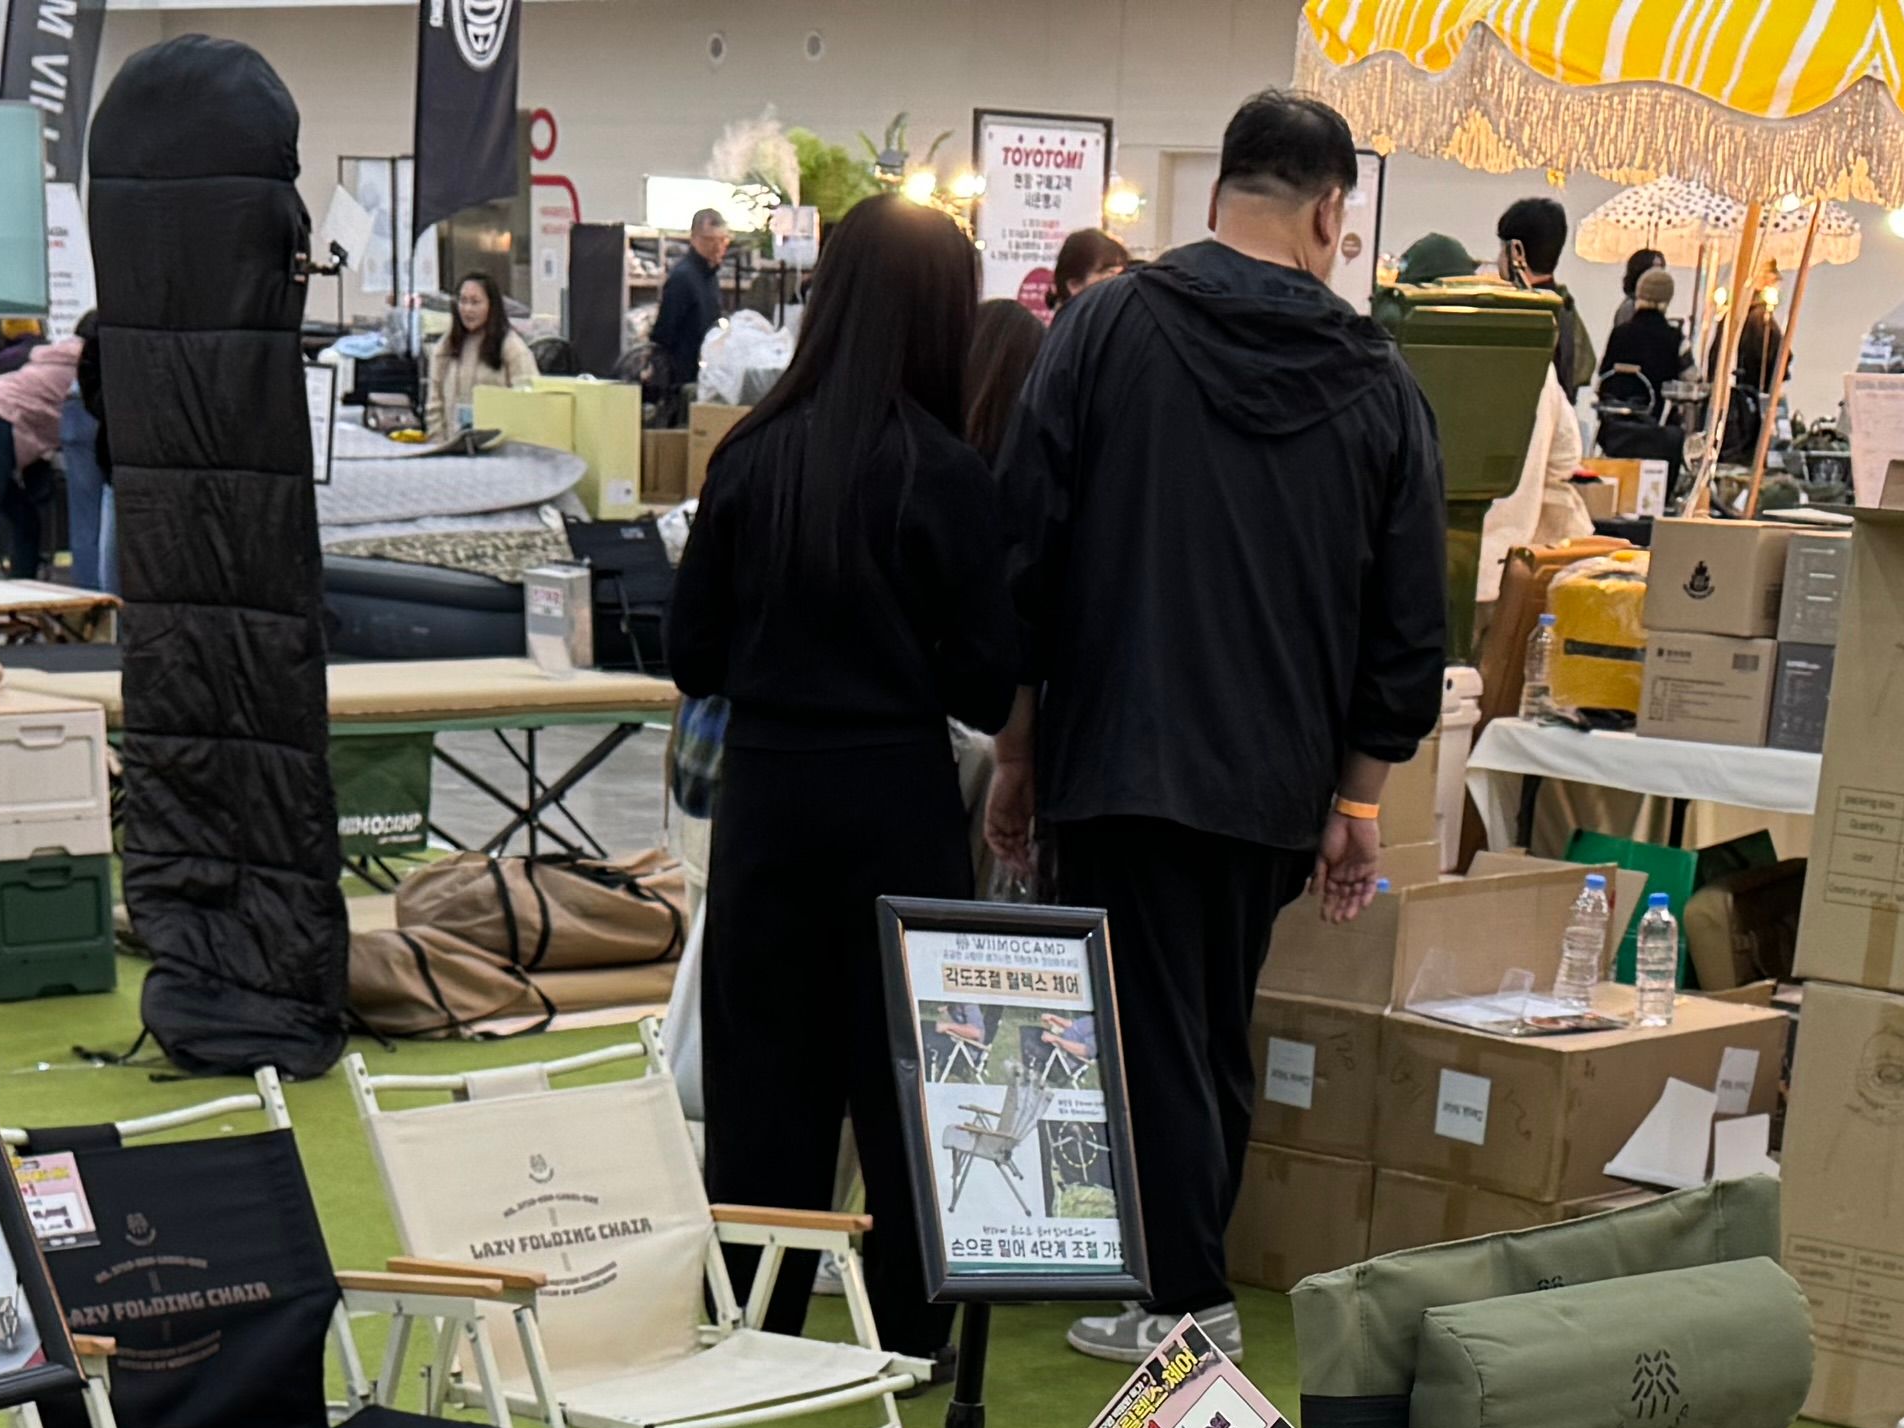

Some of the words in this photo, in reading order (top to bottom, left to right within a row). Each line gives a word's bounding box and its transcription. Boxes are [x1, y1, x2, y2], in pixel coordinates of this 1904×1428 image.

[1003, 147, 1085, 169] TOYOTOMI
[945, 967, 1001, 989] 각도조절
[1006, 971, 1047, 992] 릴렉스
[1053, 973, 1079, 994] 체어
[470, 1238, 515, 1259] LAZY
[518, 1226, 597, 1253] FOLDING
[598, 1218, 653, 1240] CHAIR
[951, 1238, 994, 1257] 손으로
[998, 1239, 1026, 1258] 밀어
[1030, 1240, 1067, 1259] 4단계
[1071, 1241, 1099, 1259] 조절
[69, 1304, 110, 1327] AZY
[113, 1291, 205, 1320] FOLDING
[206, 1281, 272, 1306] CHAIR
[1161, 1346, 1199, 1389] 체어
